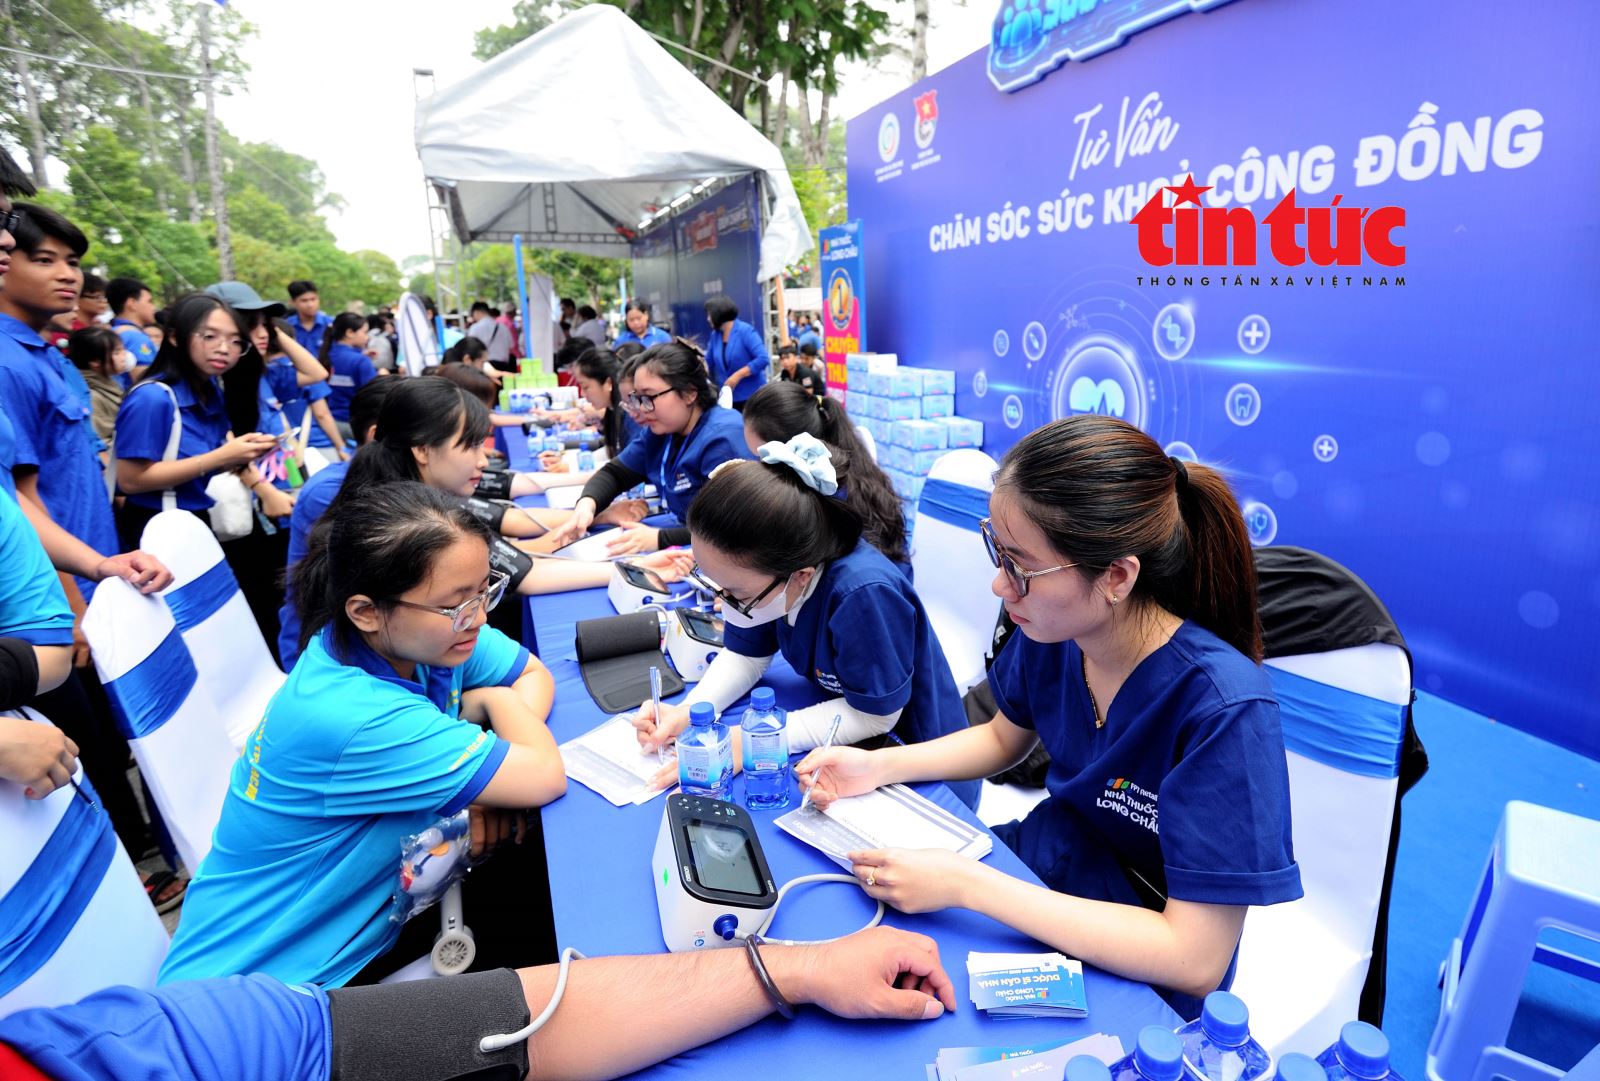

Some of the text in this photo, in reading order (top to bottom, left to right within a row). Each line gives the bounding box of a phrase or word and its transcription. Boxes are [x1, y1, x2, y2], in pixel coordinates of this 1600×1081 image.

[1069, 91, 1180, 181] Tư Vấn
[929, 212, 981, 253] CHĂM
[986, 201, 1031, 243] SÓC
[1037, 188, 1095, 235] SỨC
[1353, 101, 1544, 188] ĐỒNG
[1096, 797, 1129, 817] LONG
[1104, 789, 1159, 818] NHÀ THUỐC
